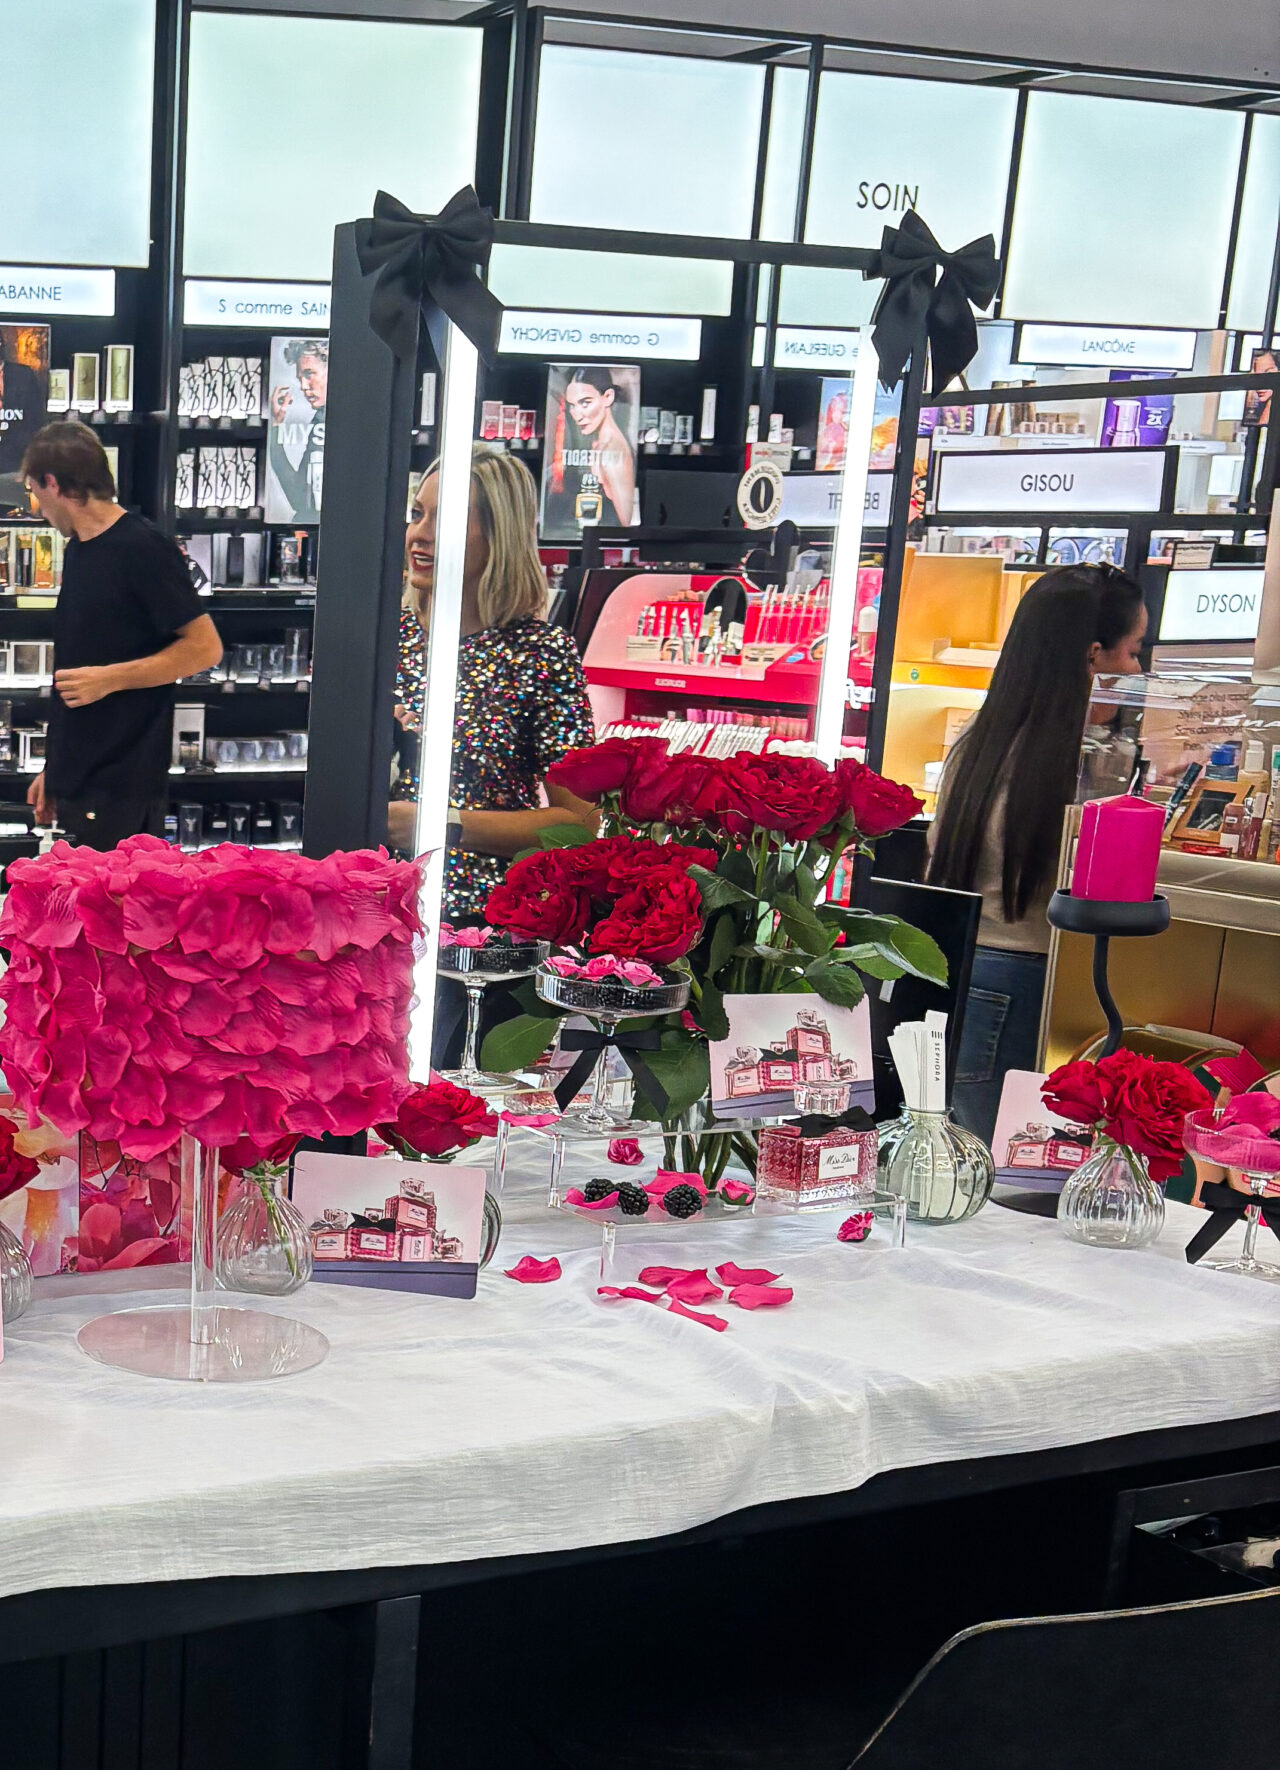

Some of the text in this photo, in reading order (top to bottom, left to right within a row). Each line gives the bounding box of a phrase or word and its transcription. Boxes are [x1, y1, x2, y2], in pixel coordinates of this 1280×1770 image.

[856, 181, 920, 211] SOIN
[218, 299, 227, 313] S
[234, 300, 294, 315] comme
[1081, 338, 1136, 354] LANCÔME
[1020, 474, 1075, 493] GISOU
[1196, 593, 1257, 614] DYSON
[823, 1154, 841, 1165] Miss
